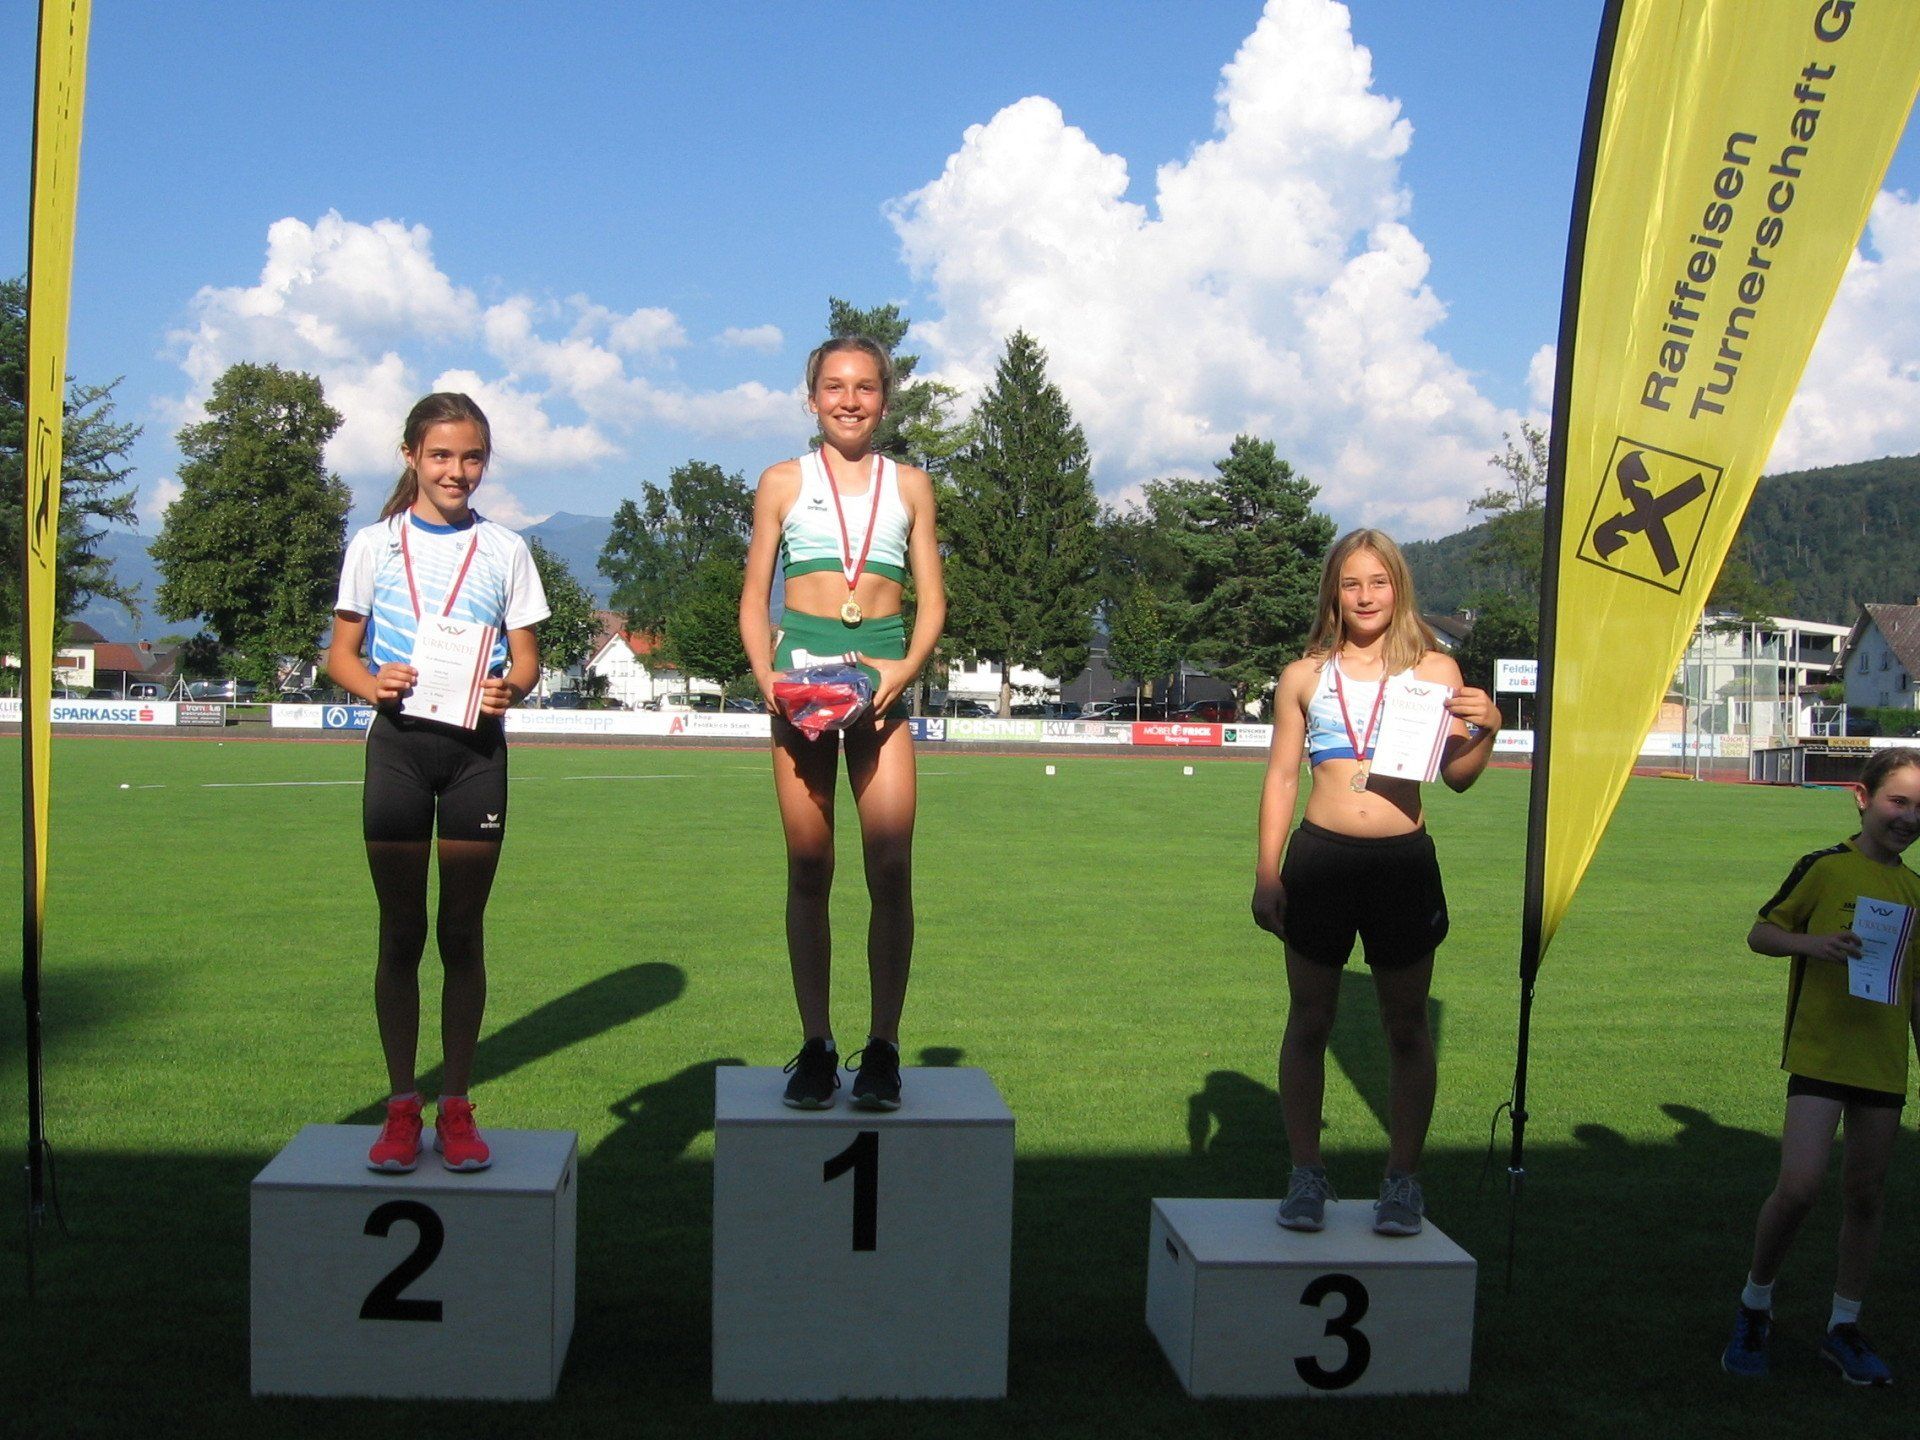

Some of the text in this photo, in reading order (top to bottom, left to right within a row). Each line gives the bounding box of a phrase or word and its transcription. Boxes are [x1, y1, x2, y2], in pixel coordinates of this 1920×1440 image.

[1640, 131, 1757, 412] Raiffeisen
[1690, 60, 1836, 420] Turnerschaft
[422, 636, 475, 656] URKUNDE
[53, 707, 137, 722] SPARKASSE
[521, 713, 614, 731] biedenkapp
[950, 720, 1036, 736] FORSTNER
[822, 1129, 880, 1254] 1
[358, 1199, 445, 1323] 2
[1293, 1273, 1371, 1391] 3
